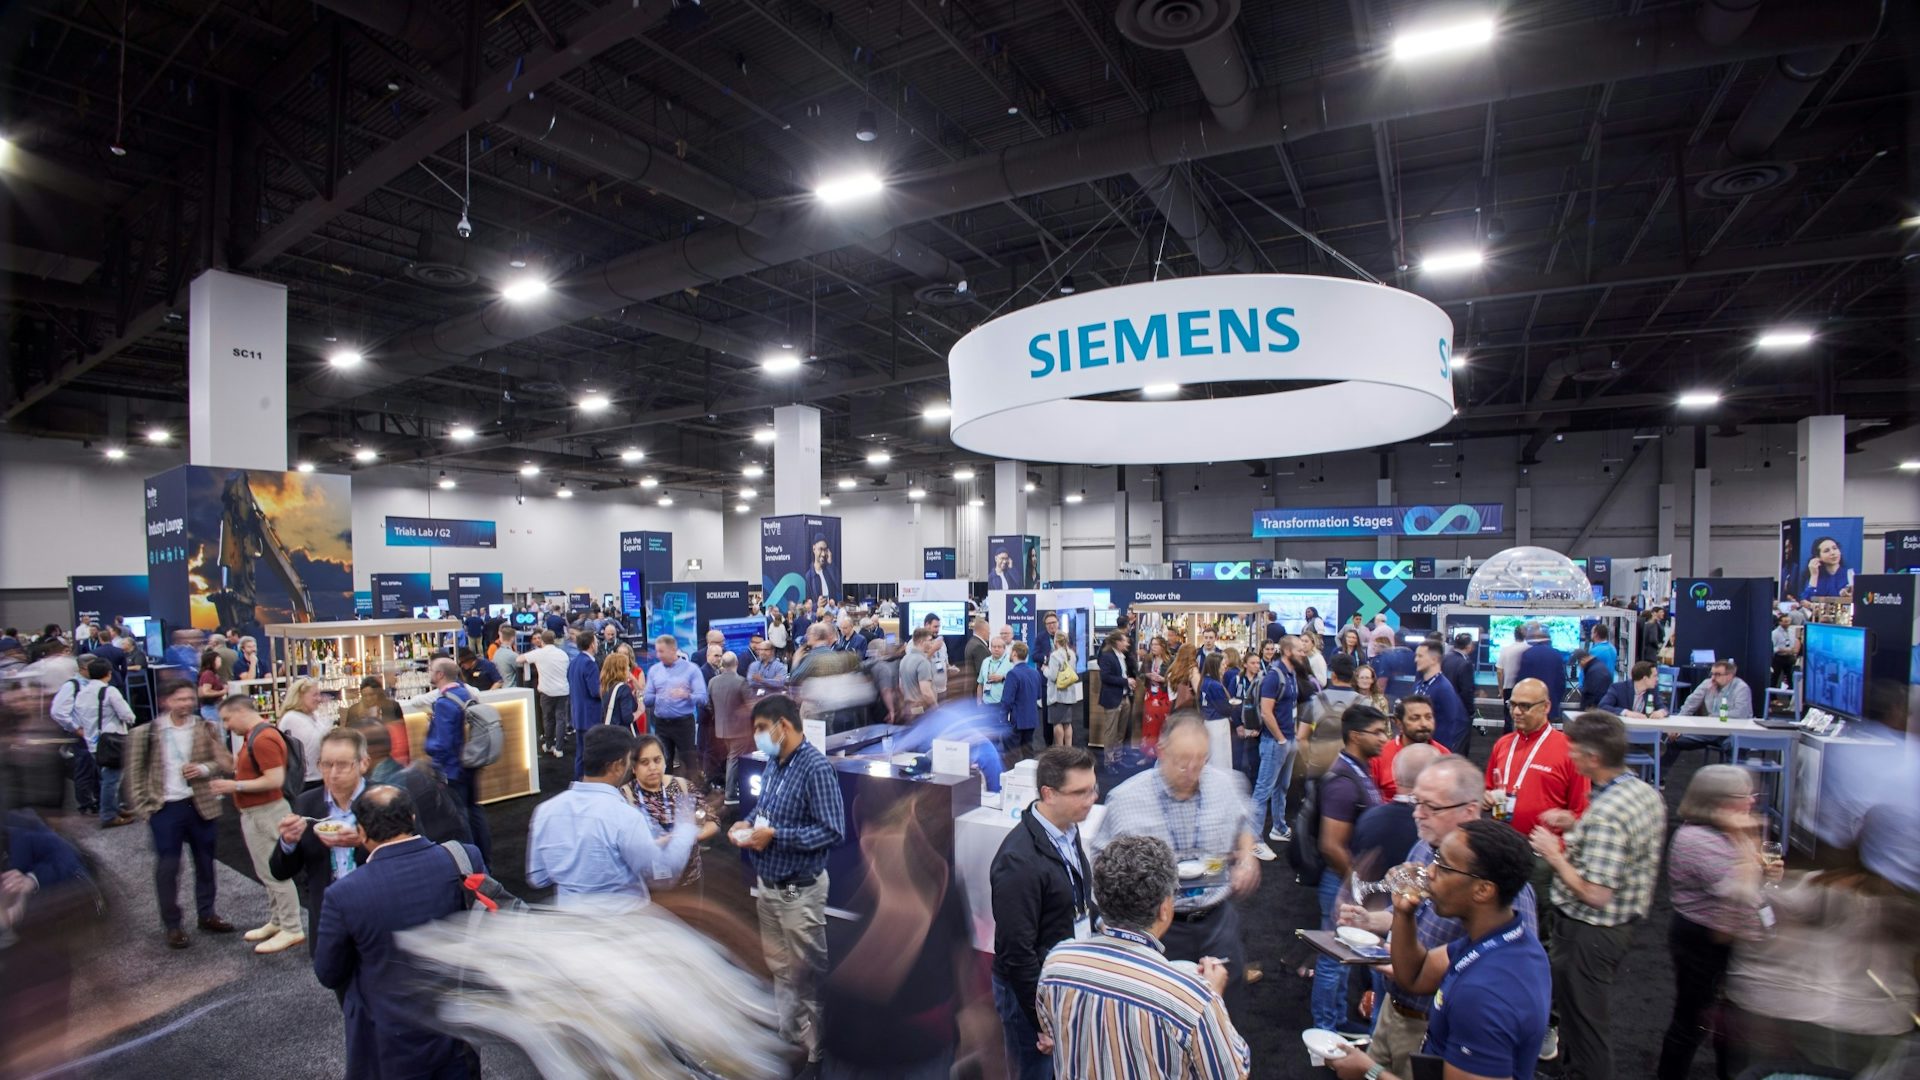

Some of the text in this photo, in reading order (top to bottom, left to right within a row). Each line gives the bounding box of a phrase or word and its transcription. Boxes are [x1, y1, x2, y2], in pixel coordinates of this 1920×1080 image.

[1028, 306, 1301, 379] SIEMENS
[232, 347, 262, 360] SC11
[763, 521, 781, 529] Realize
[1261, 515, 1393, 530] Transformation Stages
[148, 518, 183, 537] Industry Lounge
[393, 526, 416, 537] Trials
[418, 528, 434, 537] Lab
[440, 528, 451, 538] G2
[763, 528, 781, 536] LIVE
[623, 536, 642, 545] Ask the
[623, 544, 642, 552] Experts
[764, 545, 783, 554] Today's
[764, 553, 791, 562] Innovators
[1176, 568, 1182, 578] 1
[1331, 566, 1339, 577] 2
[706, 591, 740, 600] SCHAEFFLER
[1135, 592, 1181, 600] Discover the
[1411, 593, 1465, 603] eXplore the
[1873, 592, 1902, 605] Blendhub
[1411, 604, 1421, 612] of
[1706, 604, 1731, 612] garden
